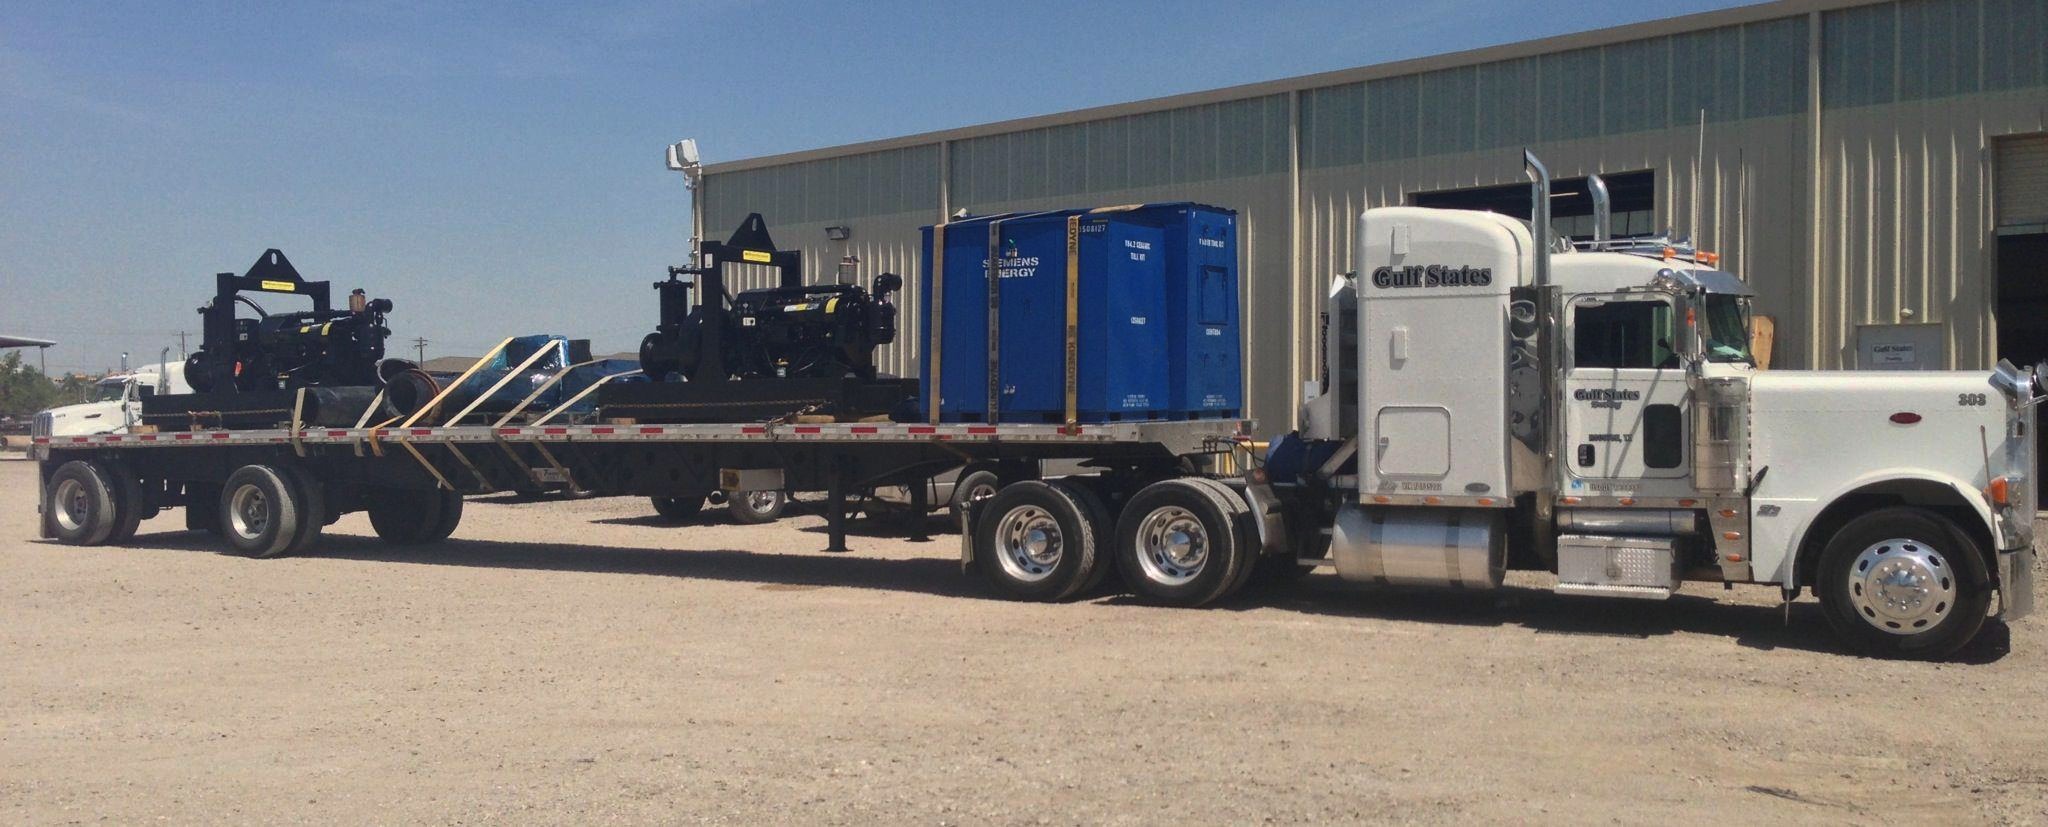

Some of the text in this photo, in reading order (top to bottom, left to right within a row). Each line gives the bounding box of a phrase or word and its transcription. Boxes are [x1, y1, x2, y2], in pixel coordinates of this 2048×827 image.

[982, 256, 1039, 268] SEMENS
[1371, 264, 1492, 289] Gulf States
[1574, 388, 1640, 401] Gulf States
